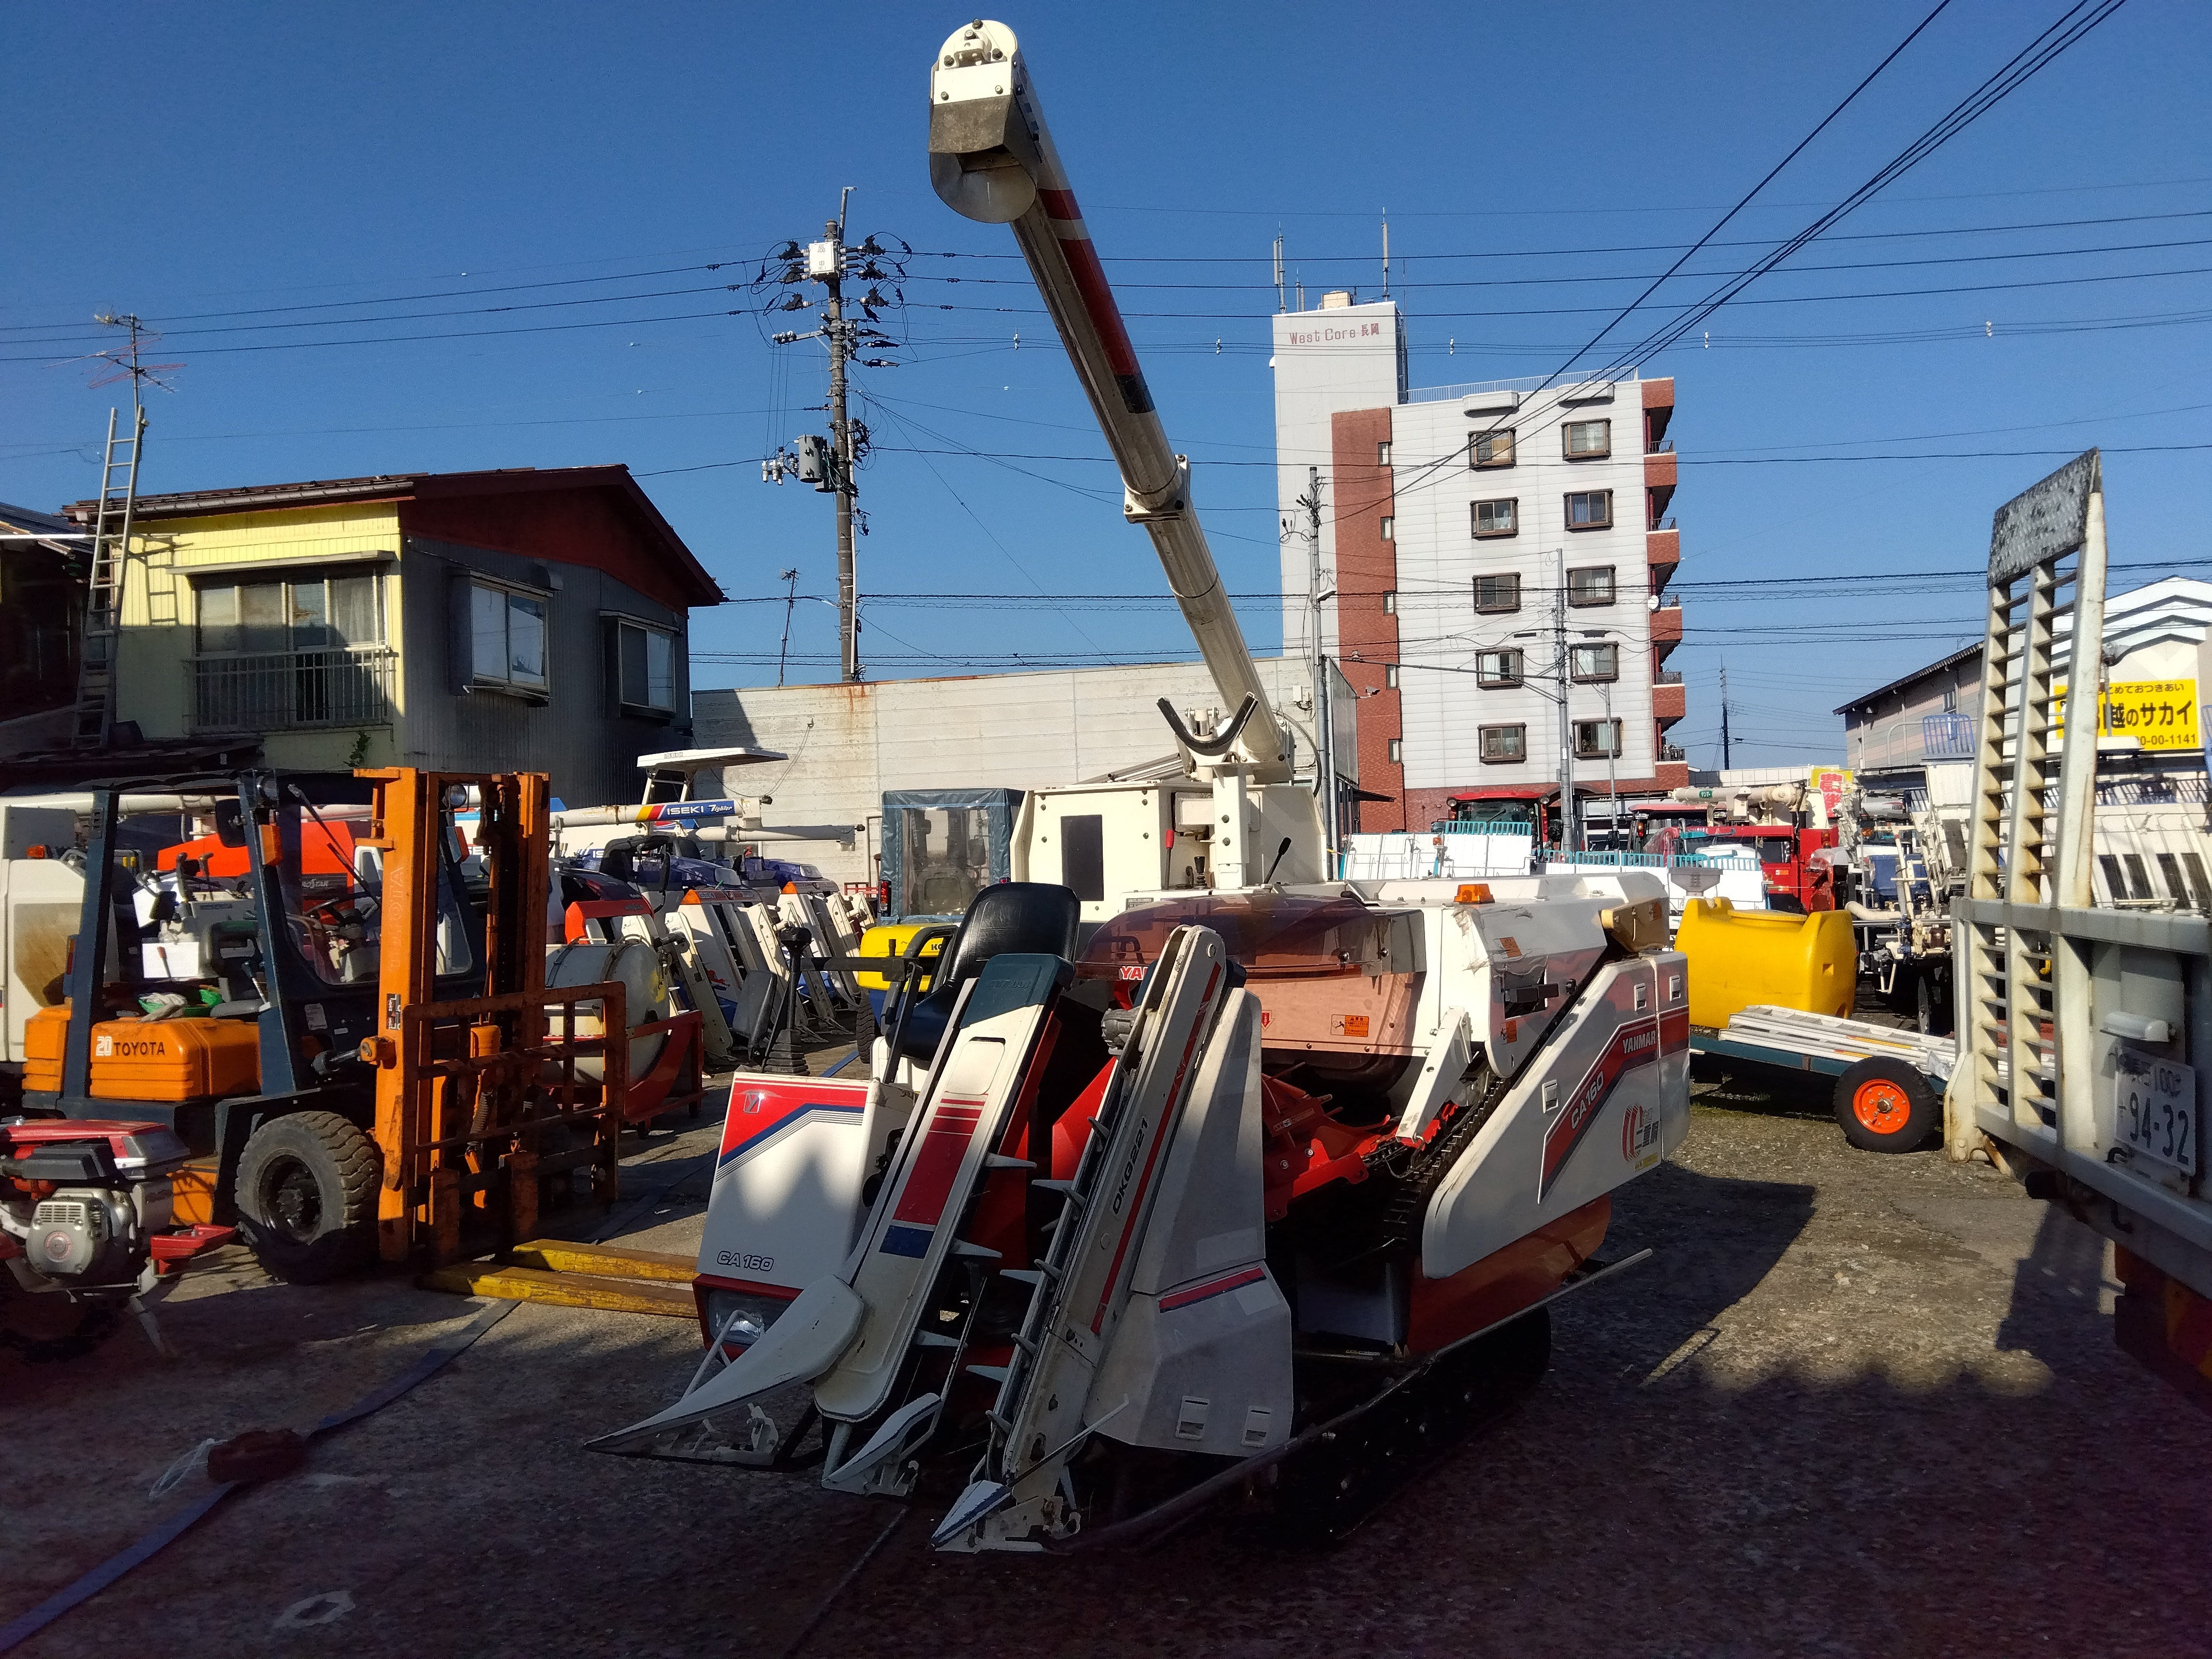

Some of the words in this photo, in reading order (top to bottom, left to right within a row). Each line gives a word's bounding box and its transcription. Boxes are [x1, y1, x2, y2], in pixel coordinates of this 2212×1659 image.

[1289, 330, 1320, 345] West
[1325, 328, 1355, 341] Core
[1361, 323, 1379, 337] 長岡
[2098, 683, 2184, 695] こめておつきあい
[2137, 733, 2196, 745] 0-00-1141
[667, 806, 704, 815] ISEKI
[1120, 966, 1148, 980] YA
[96, 1036, 112, 1056] 20
[113, 1042, 165, 1057] TOYOTA
[1622, 1030, 1656, 1054] YANMAR
